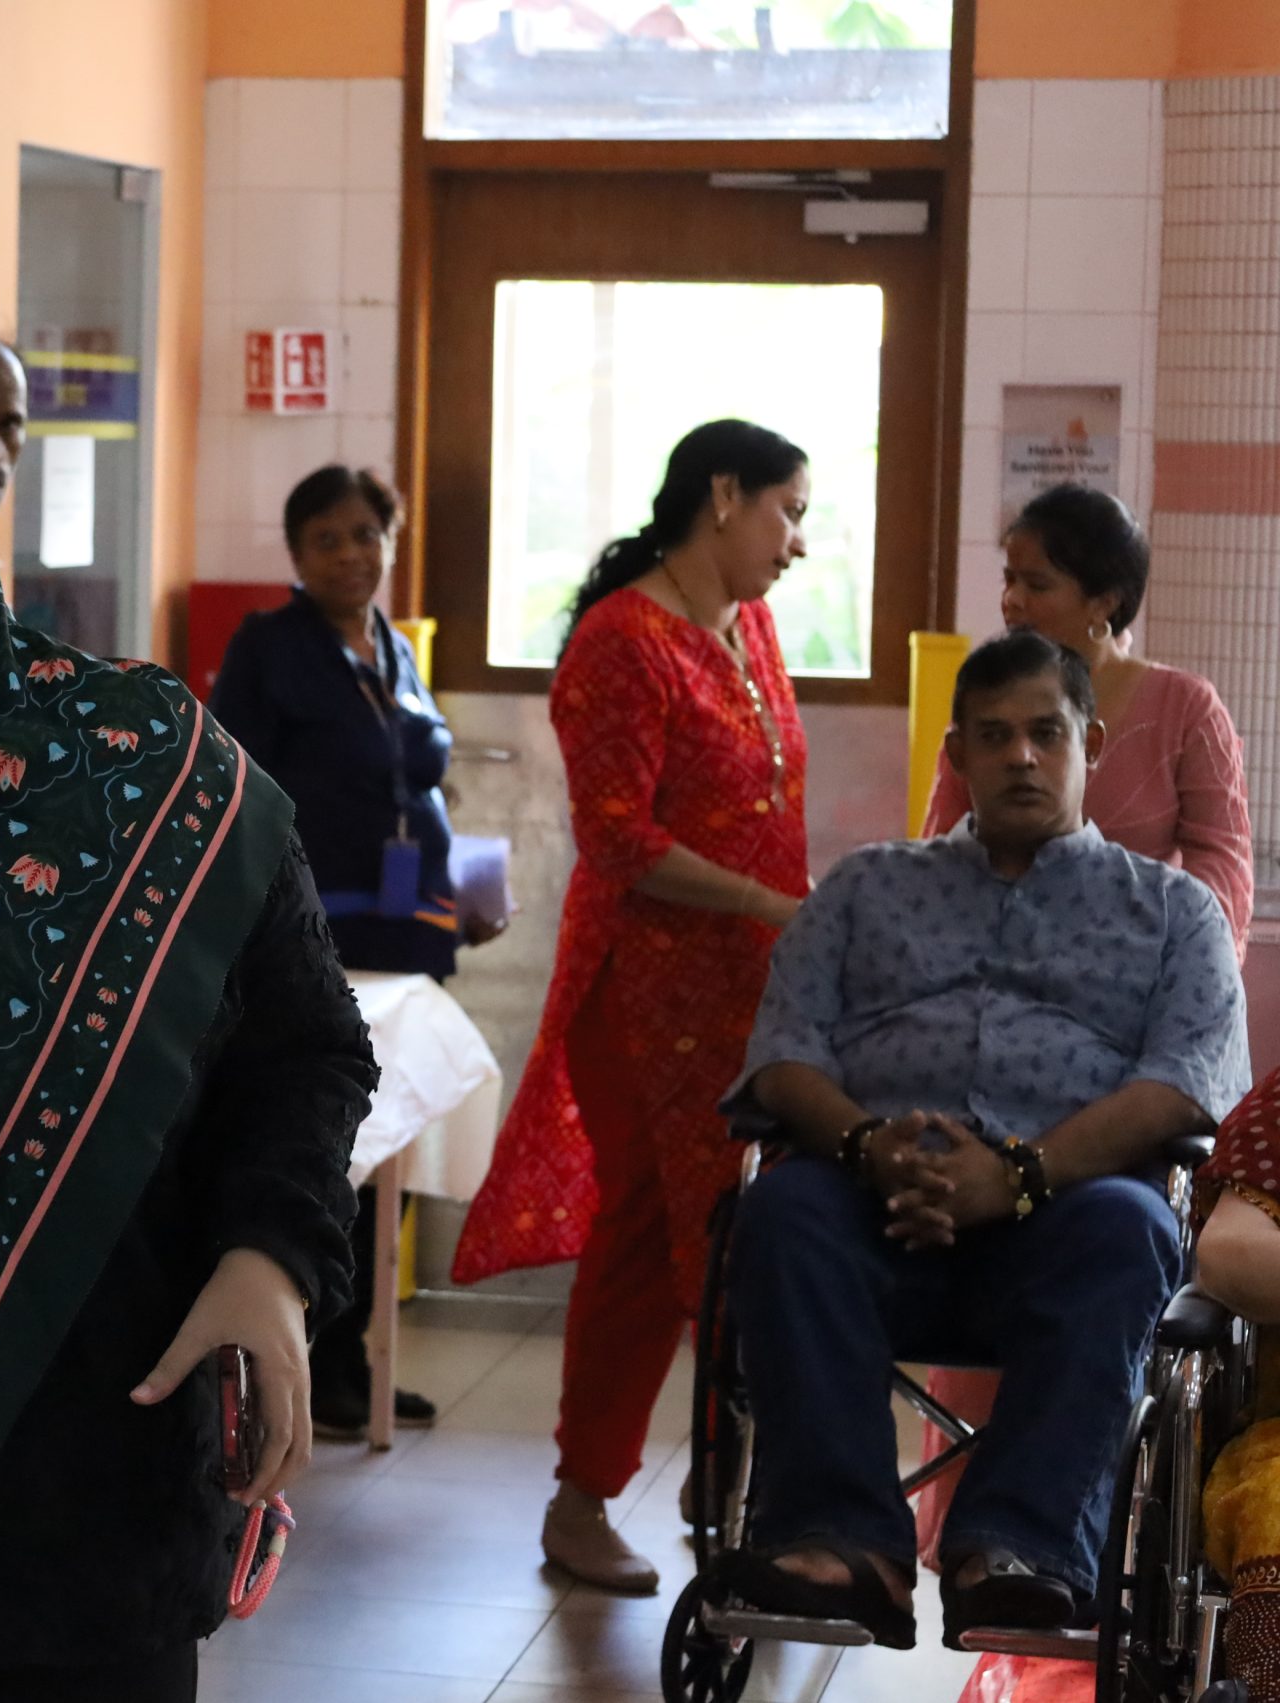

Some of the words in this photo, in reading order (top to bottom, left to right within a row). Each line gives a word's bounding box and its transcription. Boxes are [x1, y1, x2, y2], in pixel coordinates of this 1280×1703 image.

[1027, 444, 1063, 456] Have
[1067, 444, 1094, 456] You
[1078, 461, 1109, 474] Your
